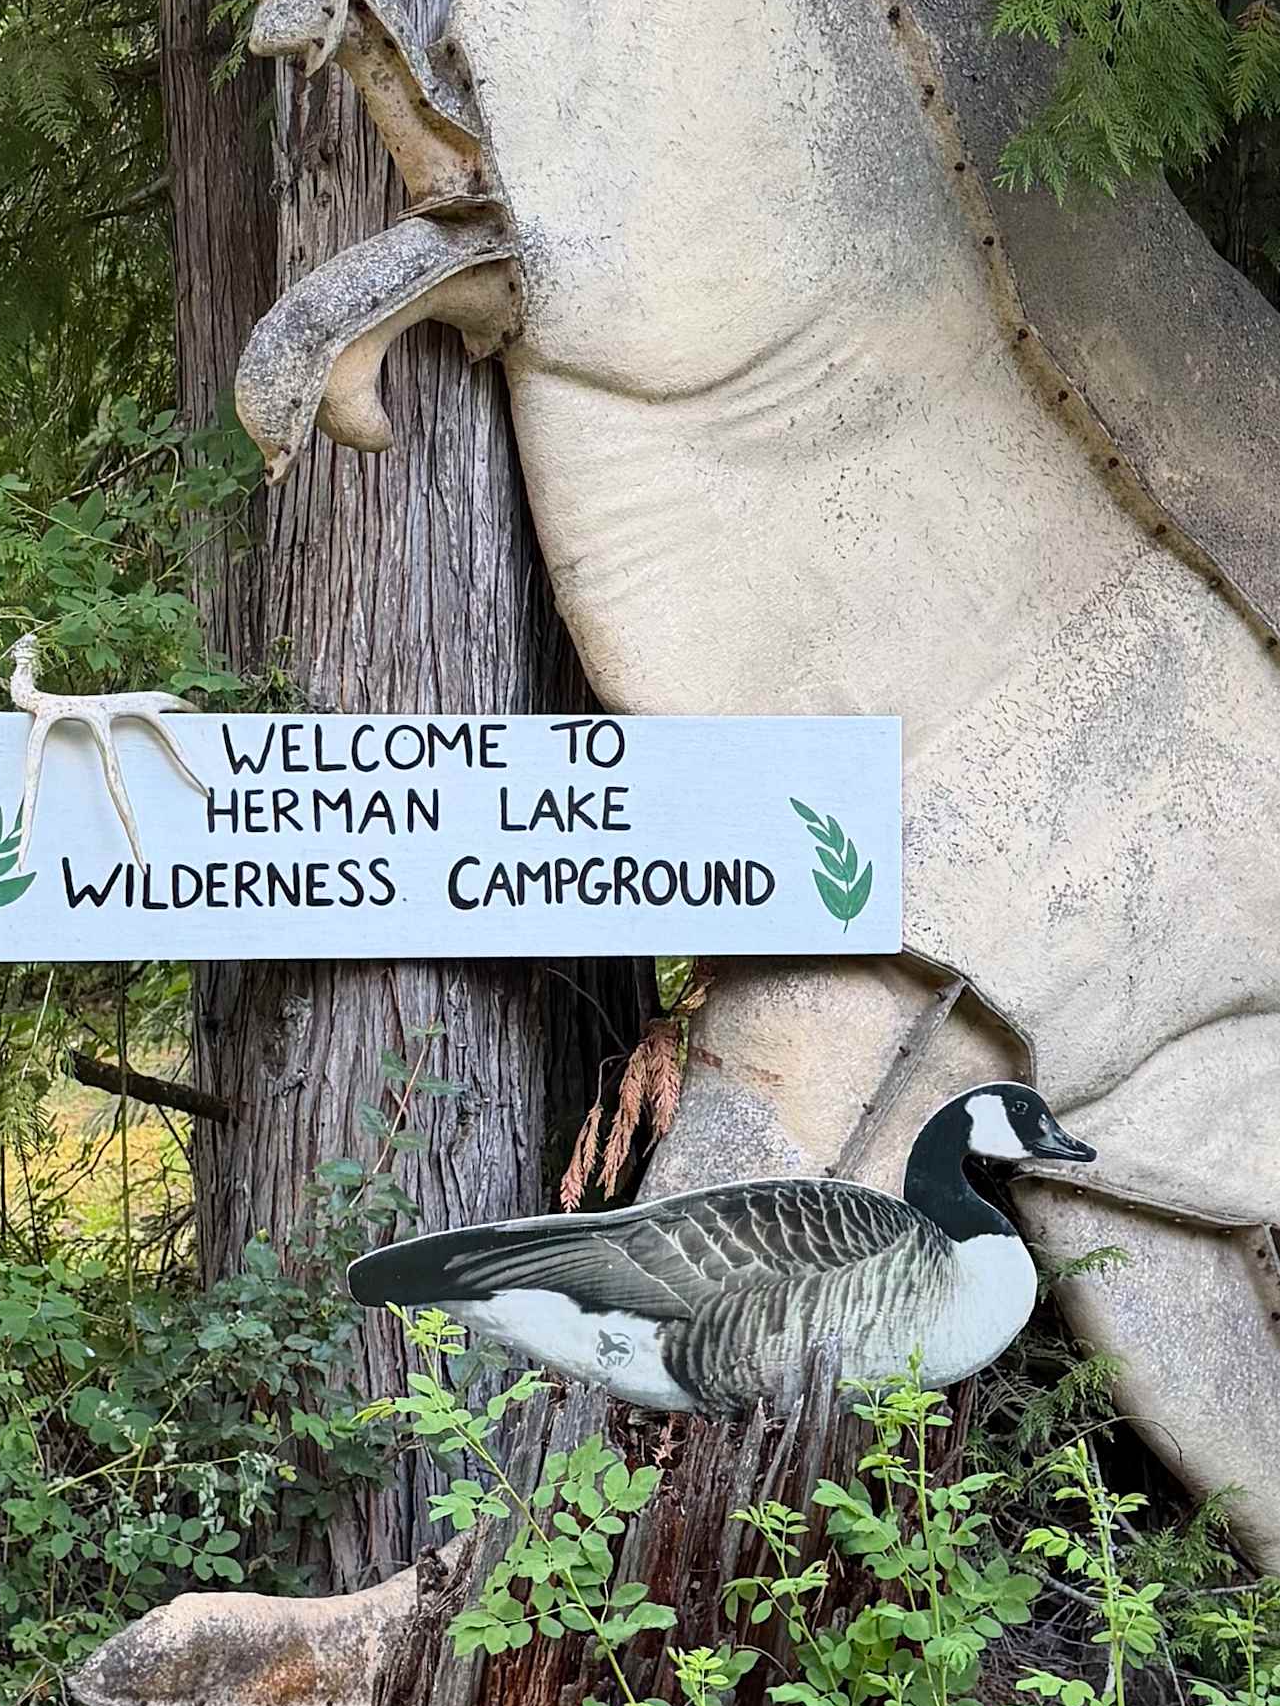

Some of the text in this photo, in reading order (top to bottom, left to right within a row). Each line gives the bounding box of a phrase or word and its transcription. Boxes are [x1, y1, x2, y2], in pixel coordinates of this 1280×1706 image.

[223, 720, 627, 776] WELCOME TO
[207, 786, 633, 836] HERMAN LAKE
[62, 855, 777, 912] WILDERNESS CAMPGROUND
